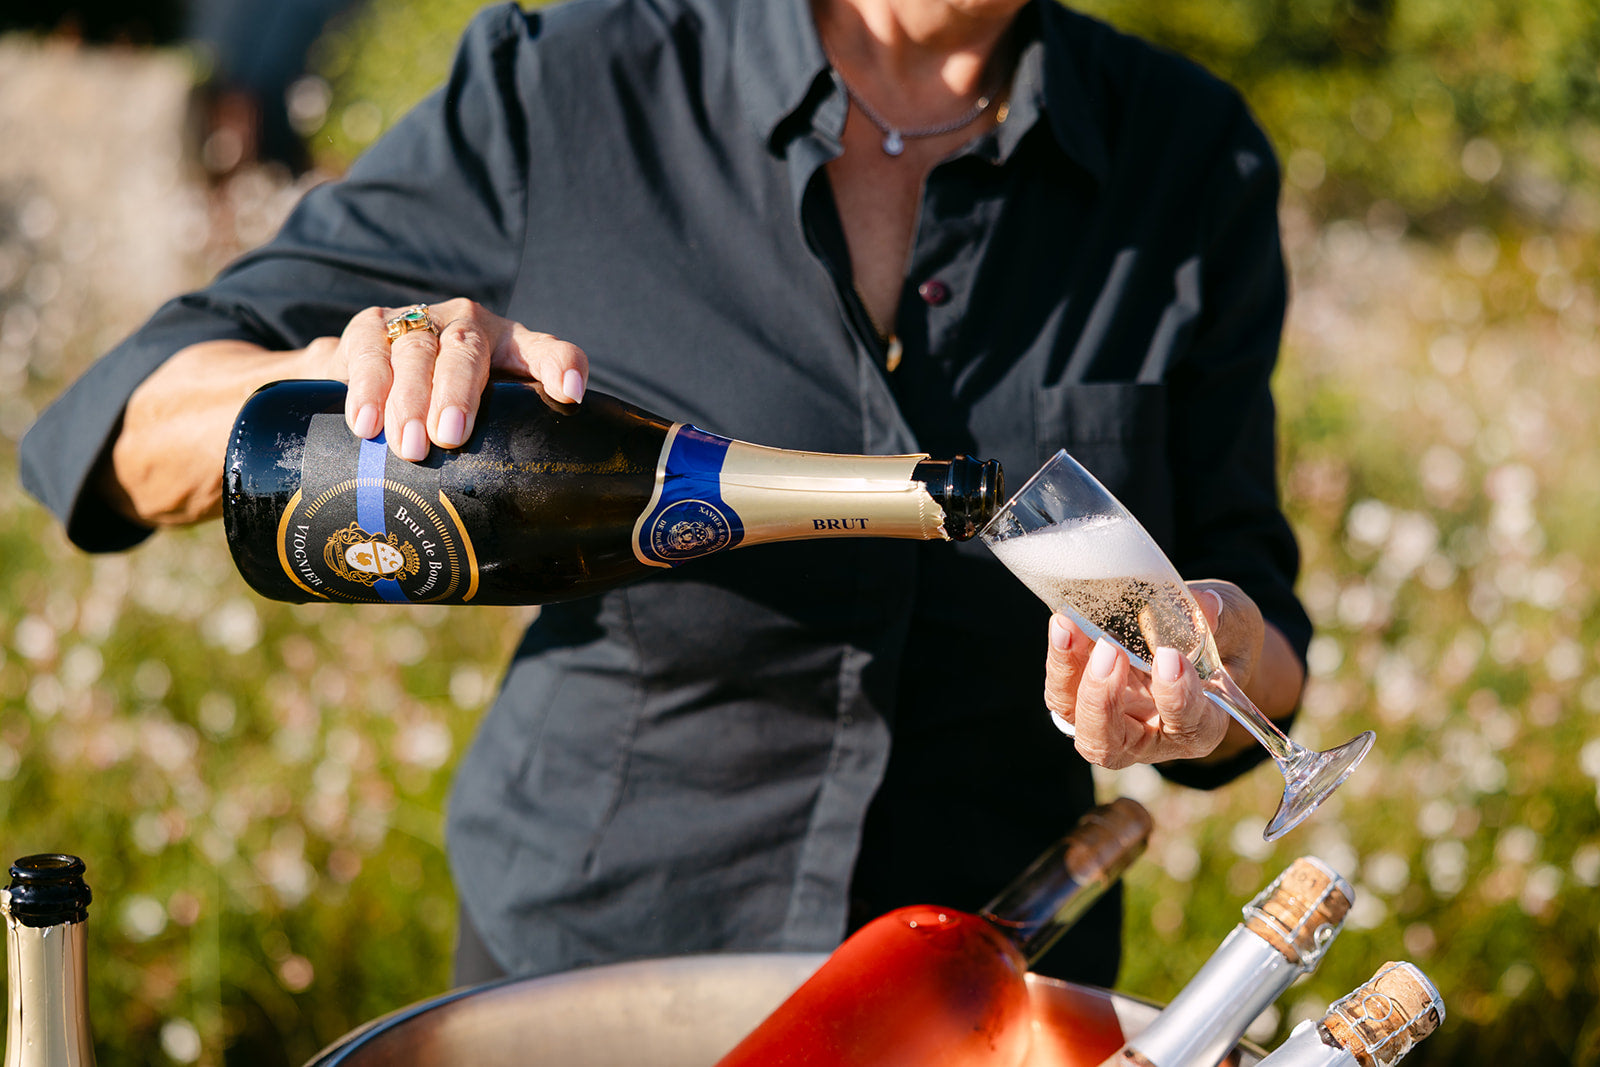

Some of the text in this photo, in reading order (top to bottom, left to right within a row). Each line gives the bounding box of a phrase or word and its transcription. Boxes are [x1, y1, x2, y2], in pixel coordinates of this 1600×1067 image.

[394, 505, 425, 539] Brut
[421, 540, 436, 557] de
[698, 506, 723, 528] XAVIER
[811, 517, 870, 531] BRUT
[293, 525, 323, 586] VIOGNIER
